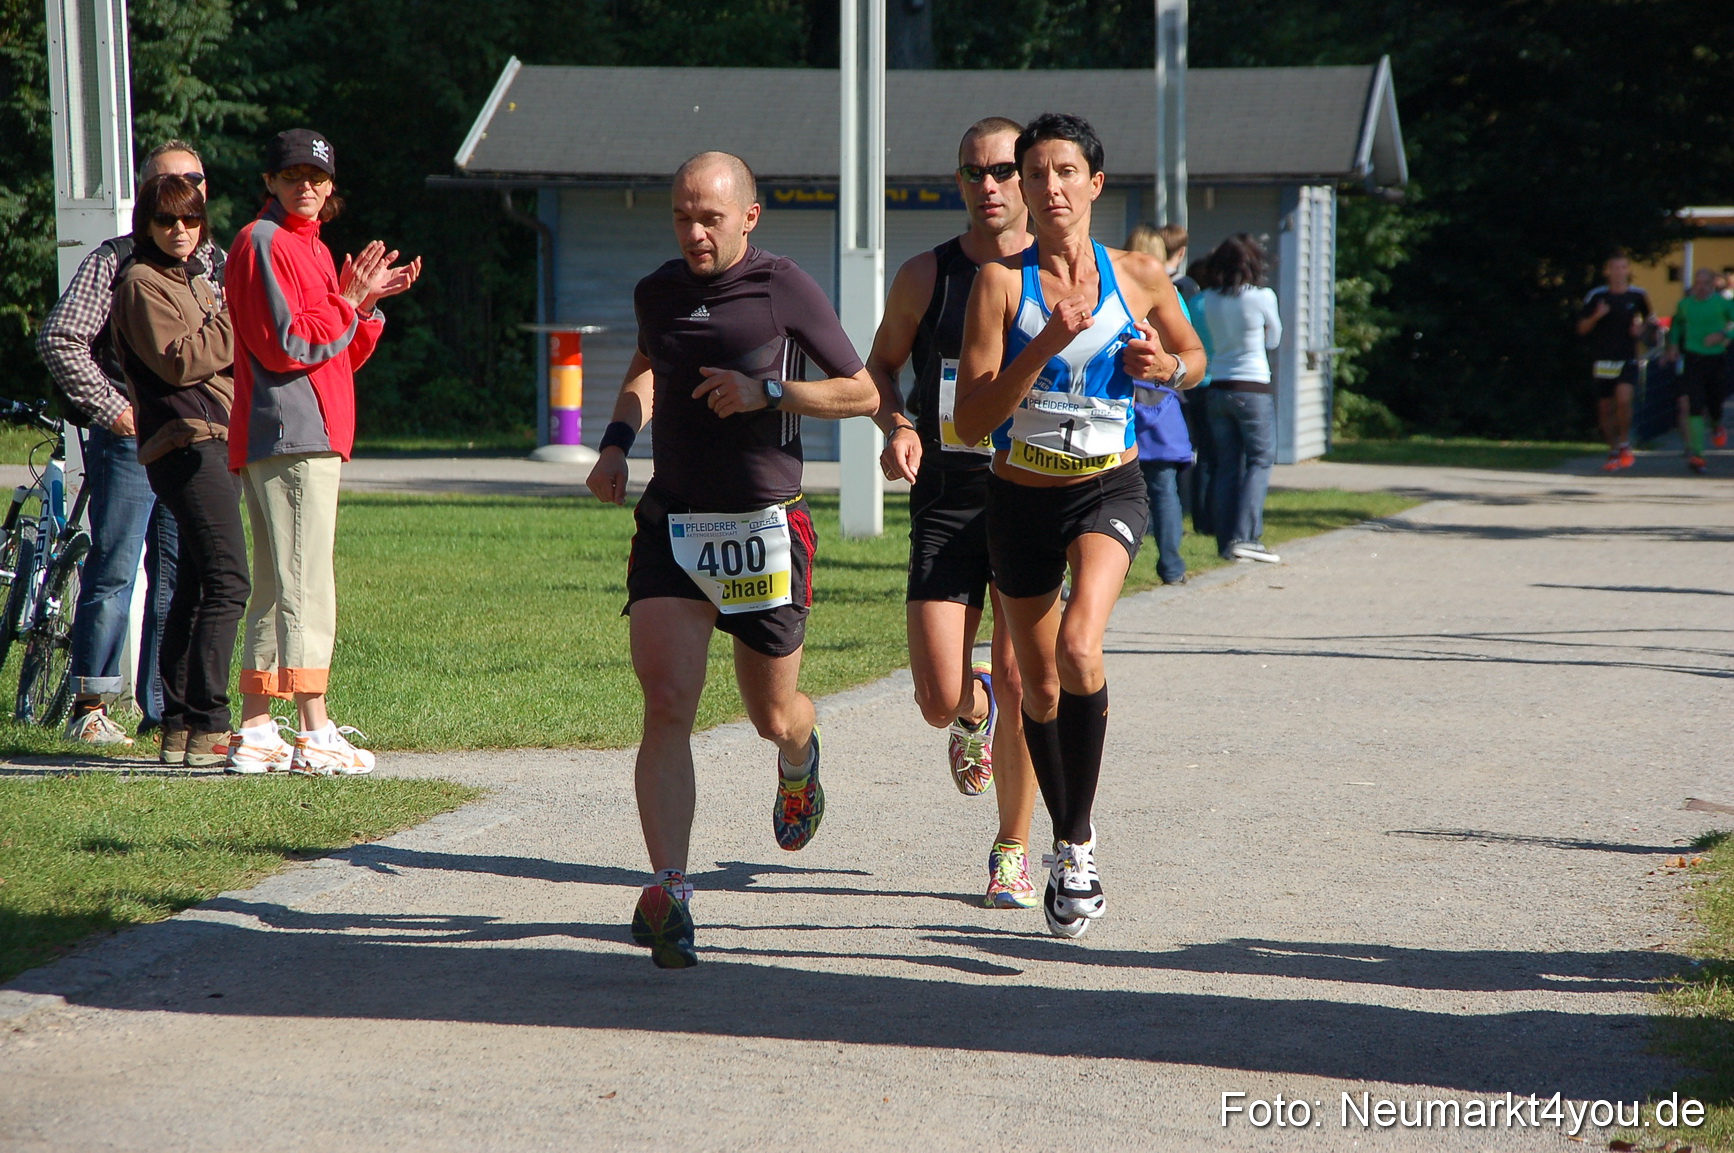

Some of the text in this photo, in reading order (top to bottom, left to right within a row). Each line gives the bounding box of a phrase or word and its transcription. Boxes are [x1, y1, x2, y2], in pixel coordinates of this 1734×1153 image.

[1029, 398, 1079, 412] PFLEIDERER
[1059, 418, 1075, 452] 1
[686, 521, 737, 532] PFLEIDERER
[697, 536, 766, 577] 400
